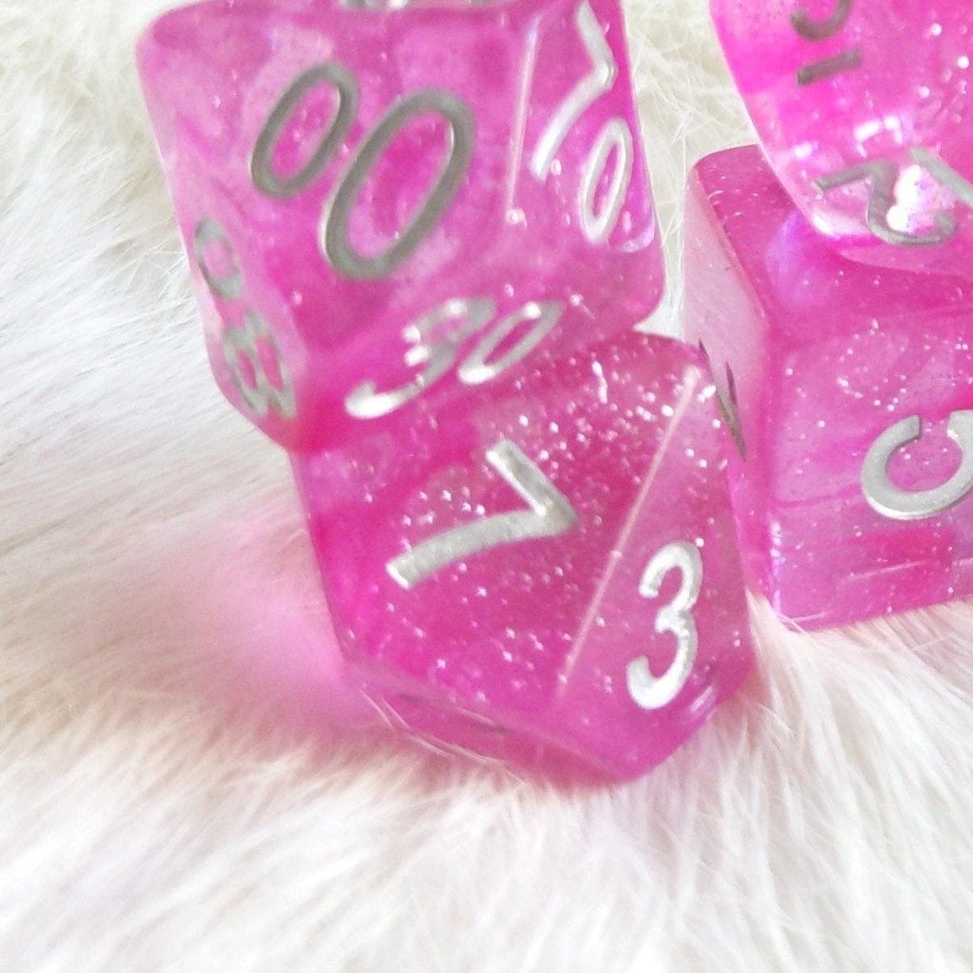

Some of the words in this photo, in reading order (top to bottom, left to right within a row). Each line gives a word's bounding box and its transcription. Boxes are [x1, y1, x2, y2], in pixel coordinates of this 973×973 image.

[249, 60, 477, 282] 00
[344, 297, 565, 419] 30
[385, 439, 580, 591] 7
[626, 541, 703, 710] 3
